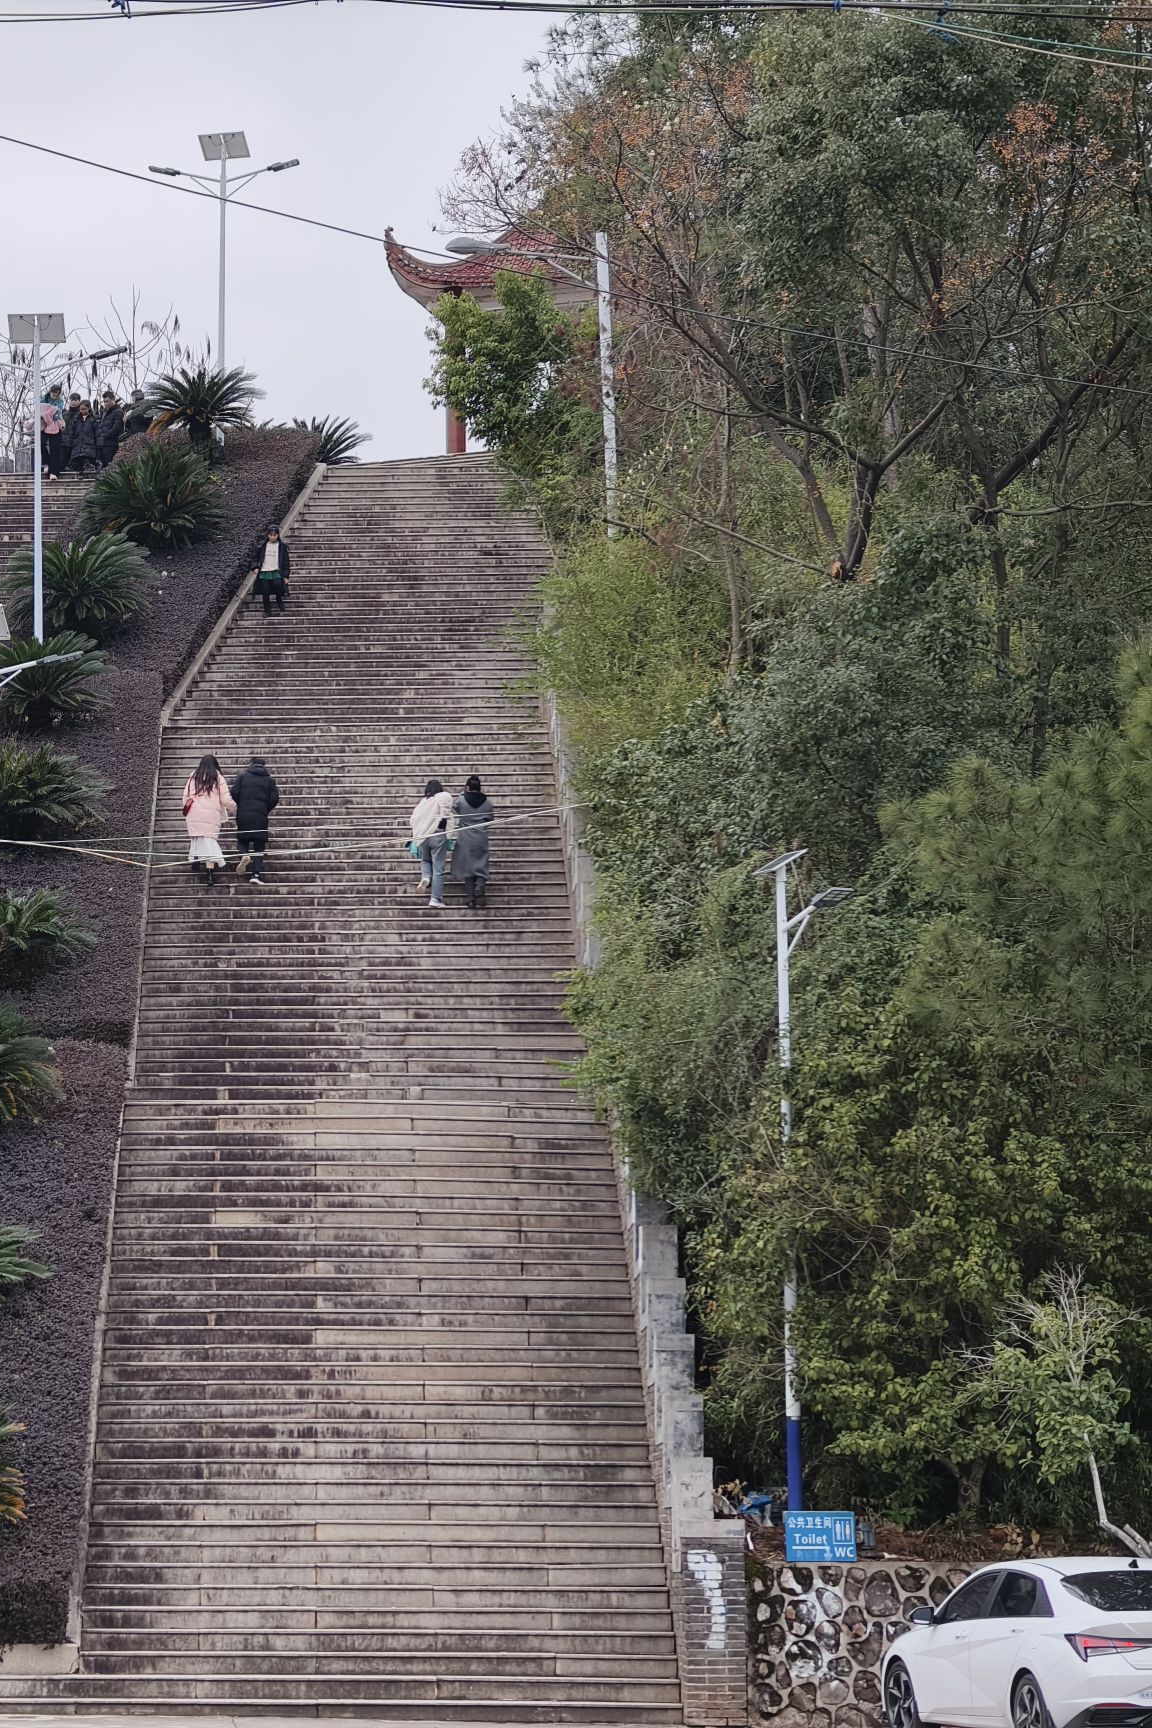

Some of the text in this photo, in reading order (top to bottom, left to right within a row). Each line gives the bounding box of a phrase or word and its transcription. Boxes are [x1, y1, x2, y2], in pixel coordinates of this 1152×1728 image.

[787, 1516, 832, 1529] 公共卫生间
[793, 1533, 828, 1545] Toilet
[834, 1547, 855, 1558] WC
